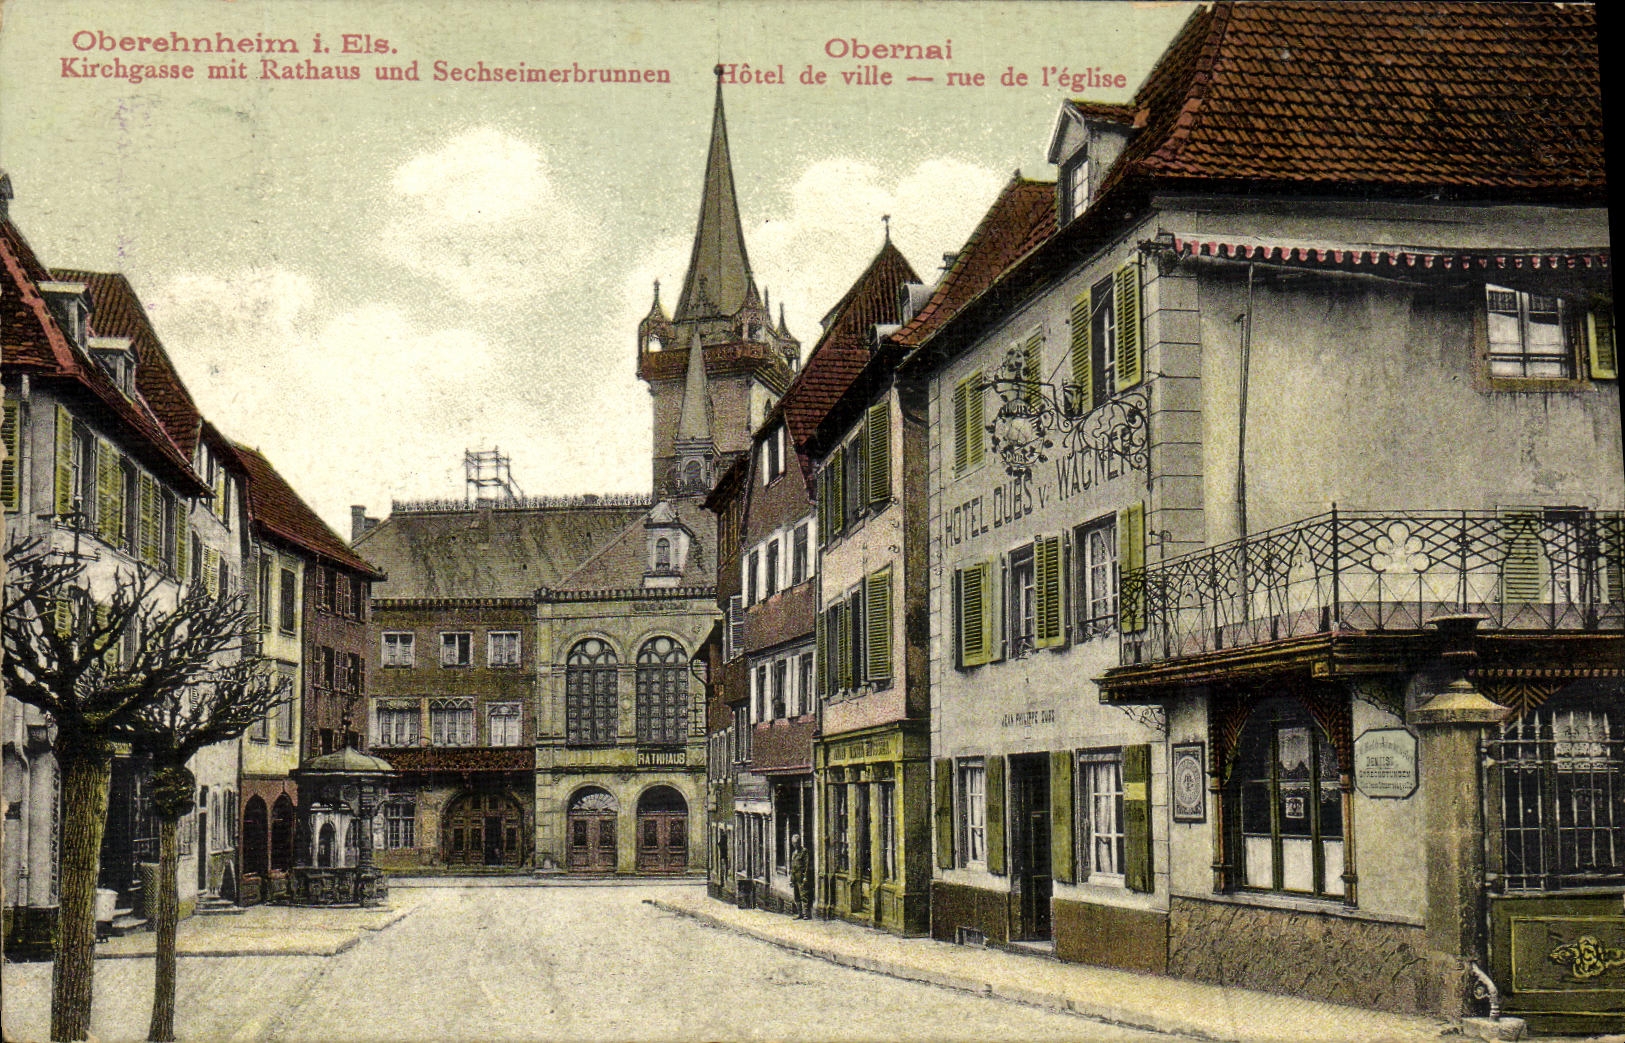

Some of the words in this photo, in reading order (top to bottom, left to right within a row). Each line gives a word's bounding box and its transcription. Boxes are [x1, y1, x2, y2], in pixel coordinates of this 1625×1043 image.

[945, 495, 989, 549] HOTEL
[994, 474, 1033, 528] DUBS
[637, 752, 686, 766] RATHHAUS
